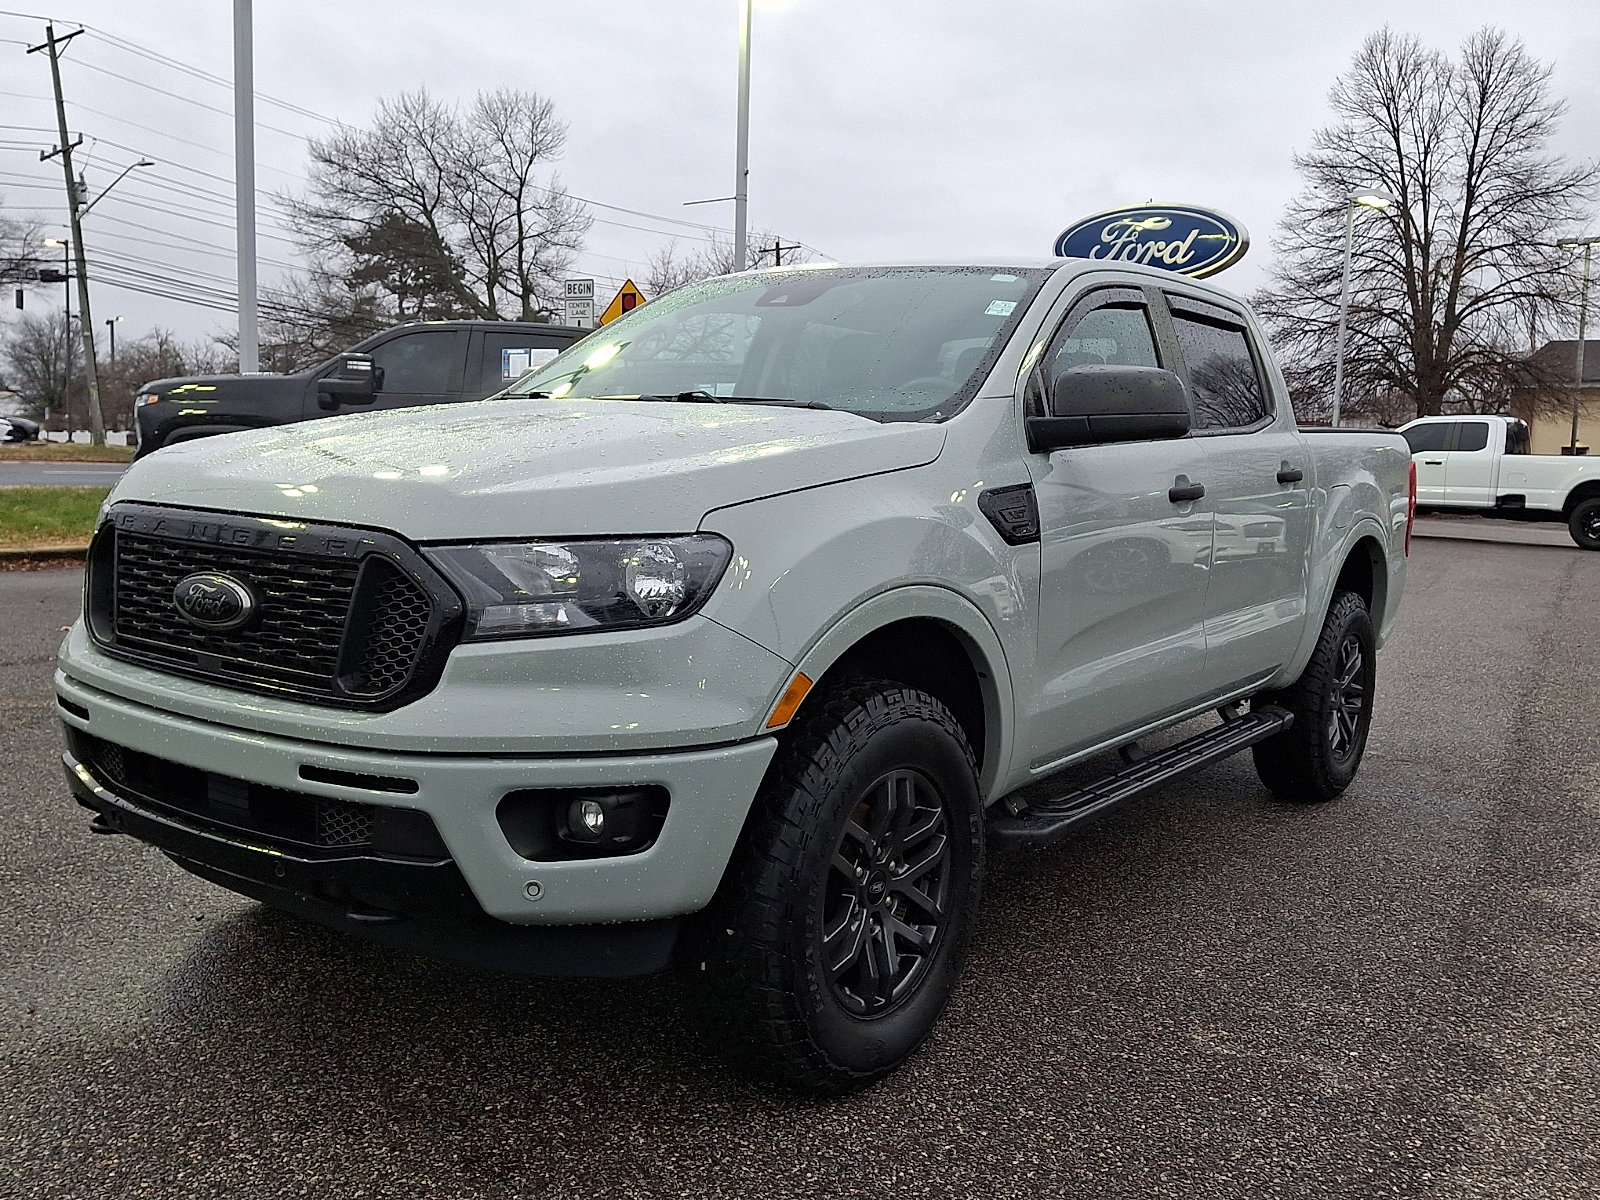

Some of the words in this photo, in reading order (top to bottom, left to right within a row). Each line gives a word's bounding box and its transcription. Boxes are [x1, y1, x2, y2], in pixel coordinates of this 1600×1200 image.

[1089, 216, 1200, 265] Ford
[567, 283, 592, 294] BEGIN
[121, 513, 347, 553] RANGER
[184, 583, 227, 613] Ford
